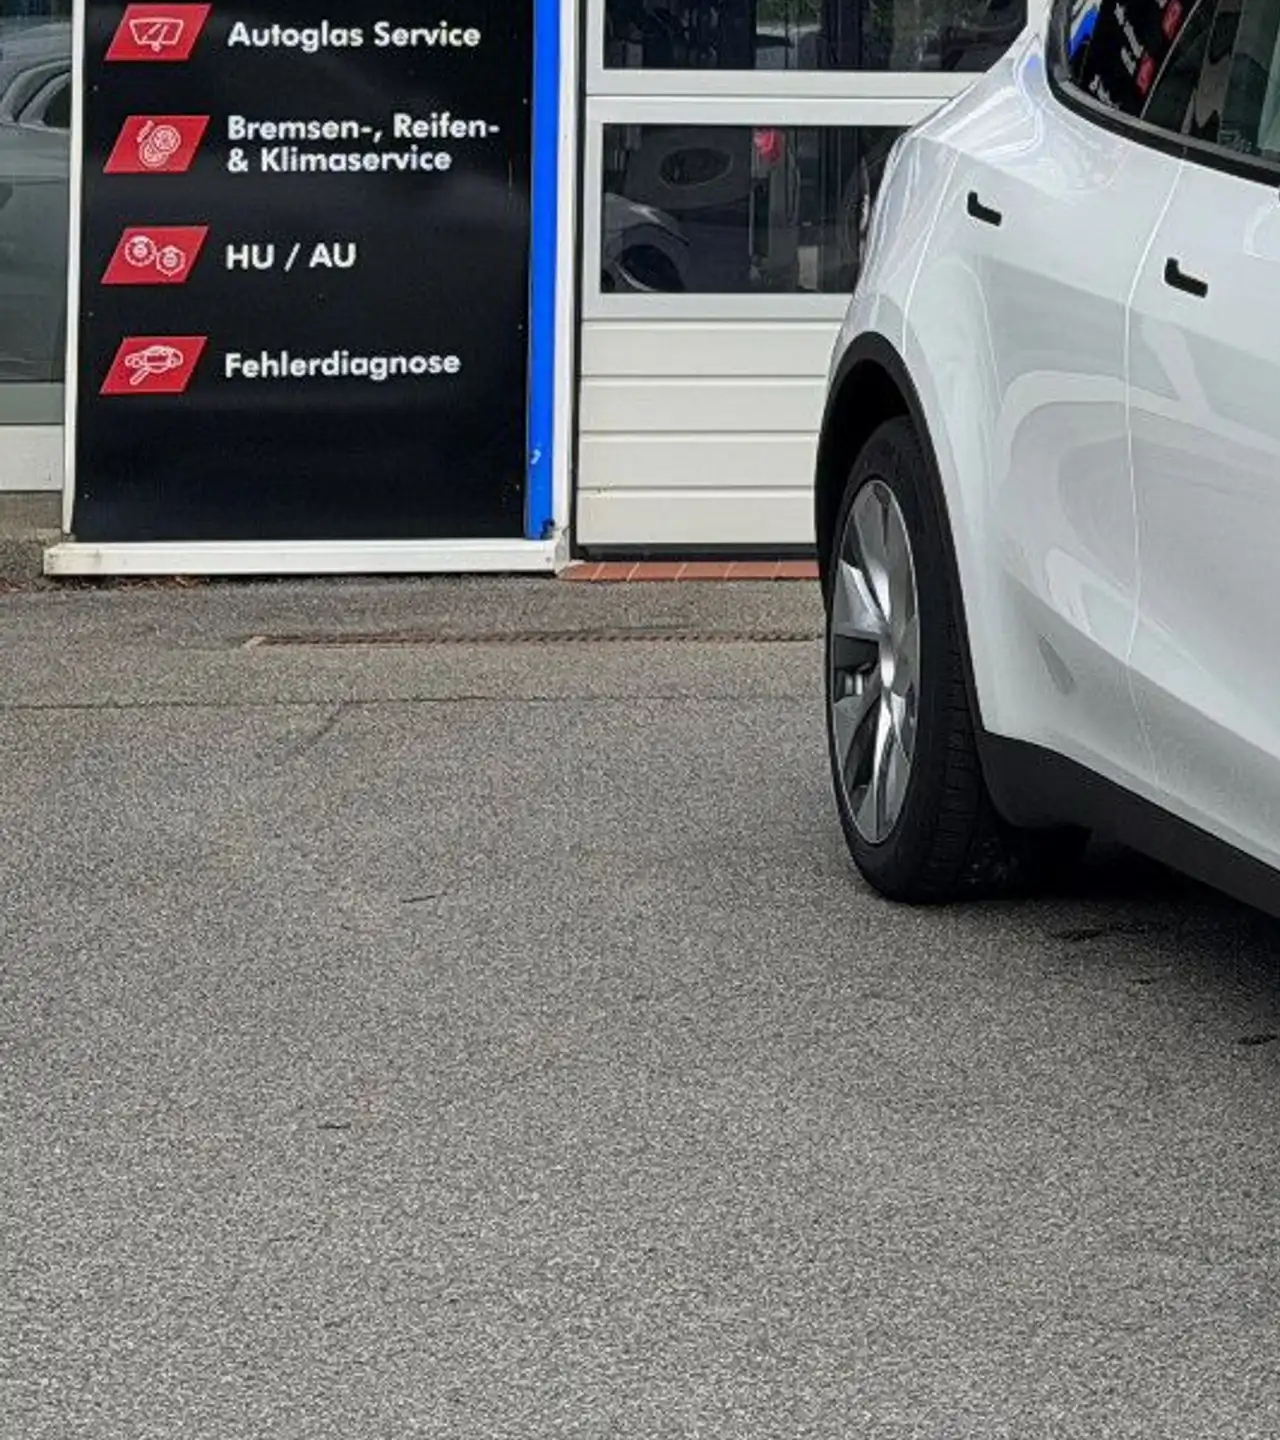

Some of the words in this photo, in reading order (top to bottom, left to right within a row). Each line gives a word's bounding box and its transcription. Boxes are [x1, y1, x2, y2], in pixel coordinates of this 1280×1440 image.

[227, 20, 364, 52] Autoglas
[374, 22, 481, 47] Service
[228, 115, 382, 143] Bremsen-,
[393, 112, 500, 138] Reifen-
[227, 147, 249, 173] &
[261, 145, 452, 172] Klimaservice
[226, 244, 275, 270] HU
[309, 242, 357, 268] AU
[225, 350, 461, 380] Fehlerdiagnose
